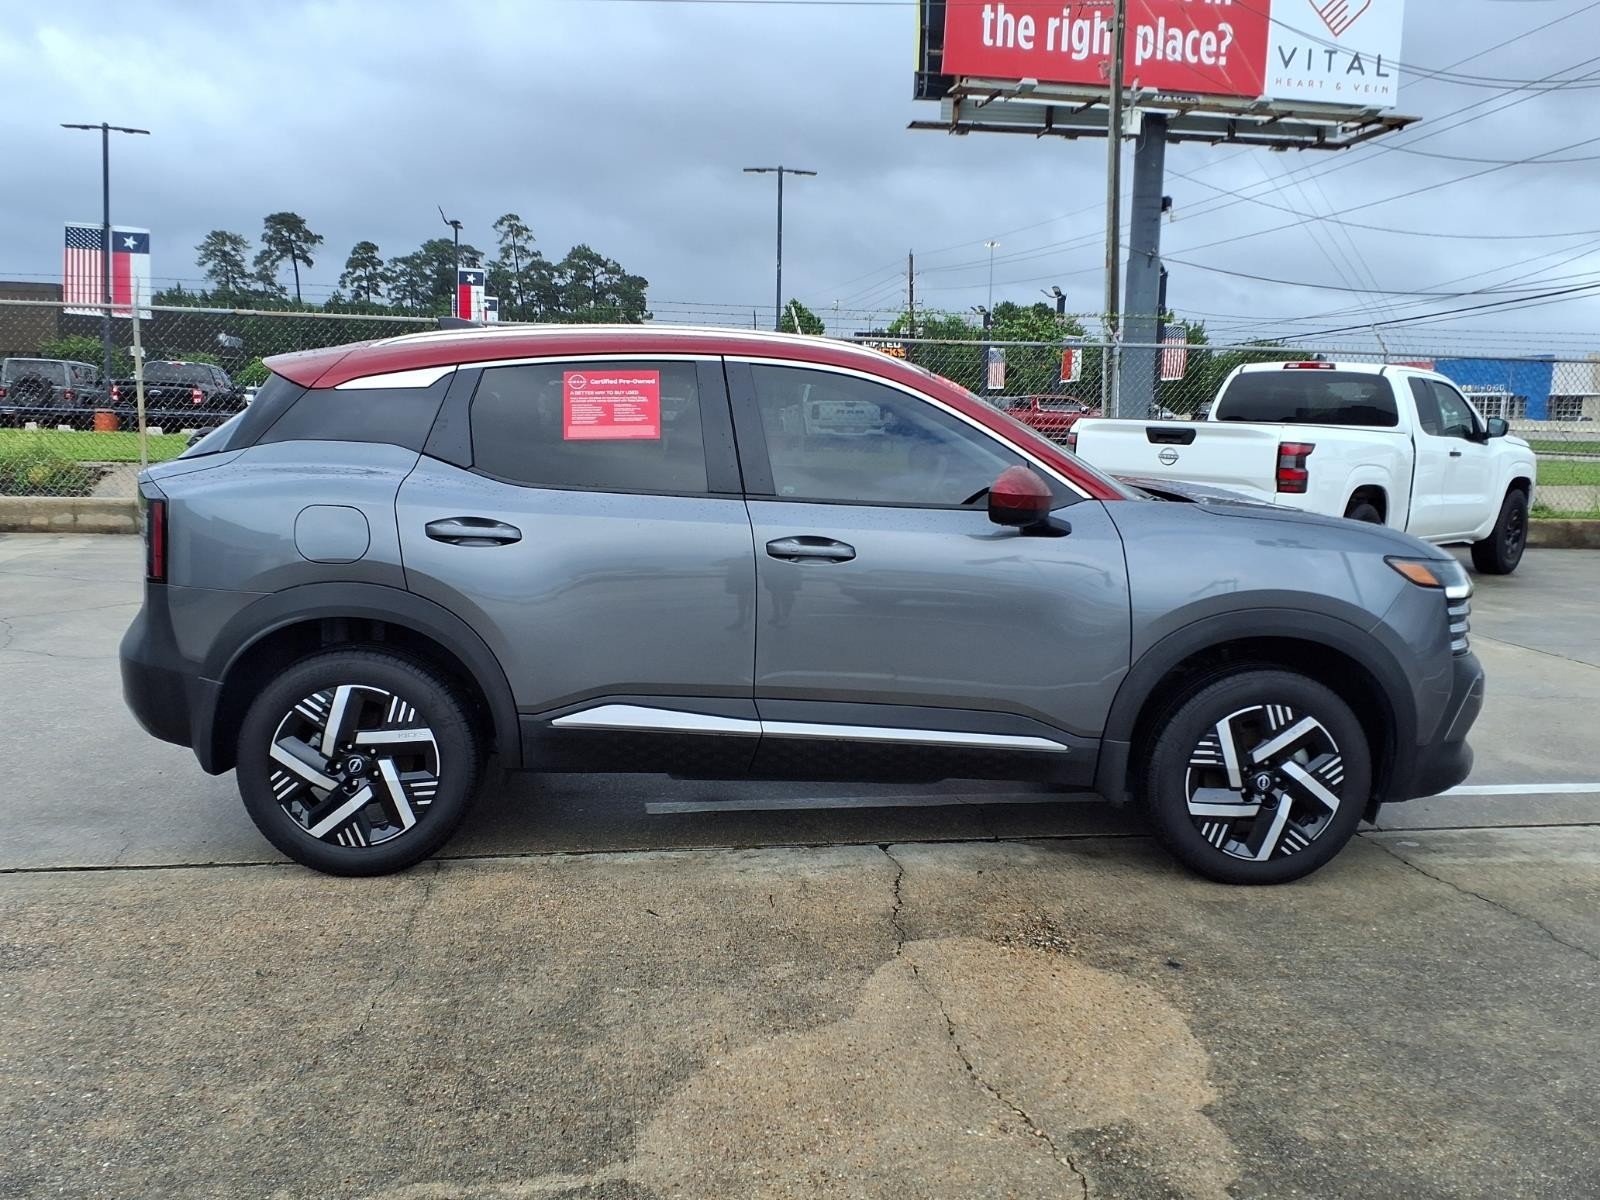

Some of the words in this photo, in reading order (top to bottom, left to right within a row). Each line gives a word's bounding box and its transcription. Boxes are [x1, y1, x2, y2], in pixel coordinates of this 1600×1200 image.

[982, 2, 1035, 50] the
[1045, 7, 1111, 61] righ
[1134, 16, 1234, 66] place?
[1278, 44, 1390, 78] VITAL
[1275, 77, 1325, 88] HEART
[1335, 82, 1342, 91] &
[1353, 84, 1389, 94] VEIN
